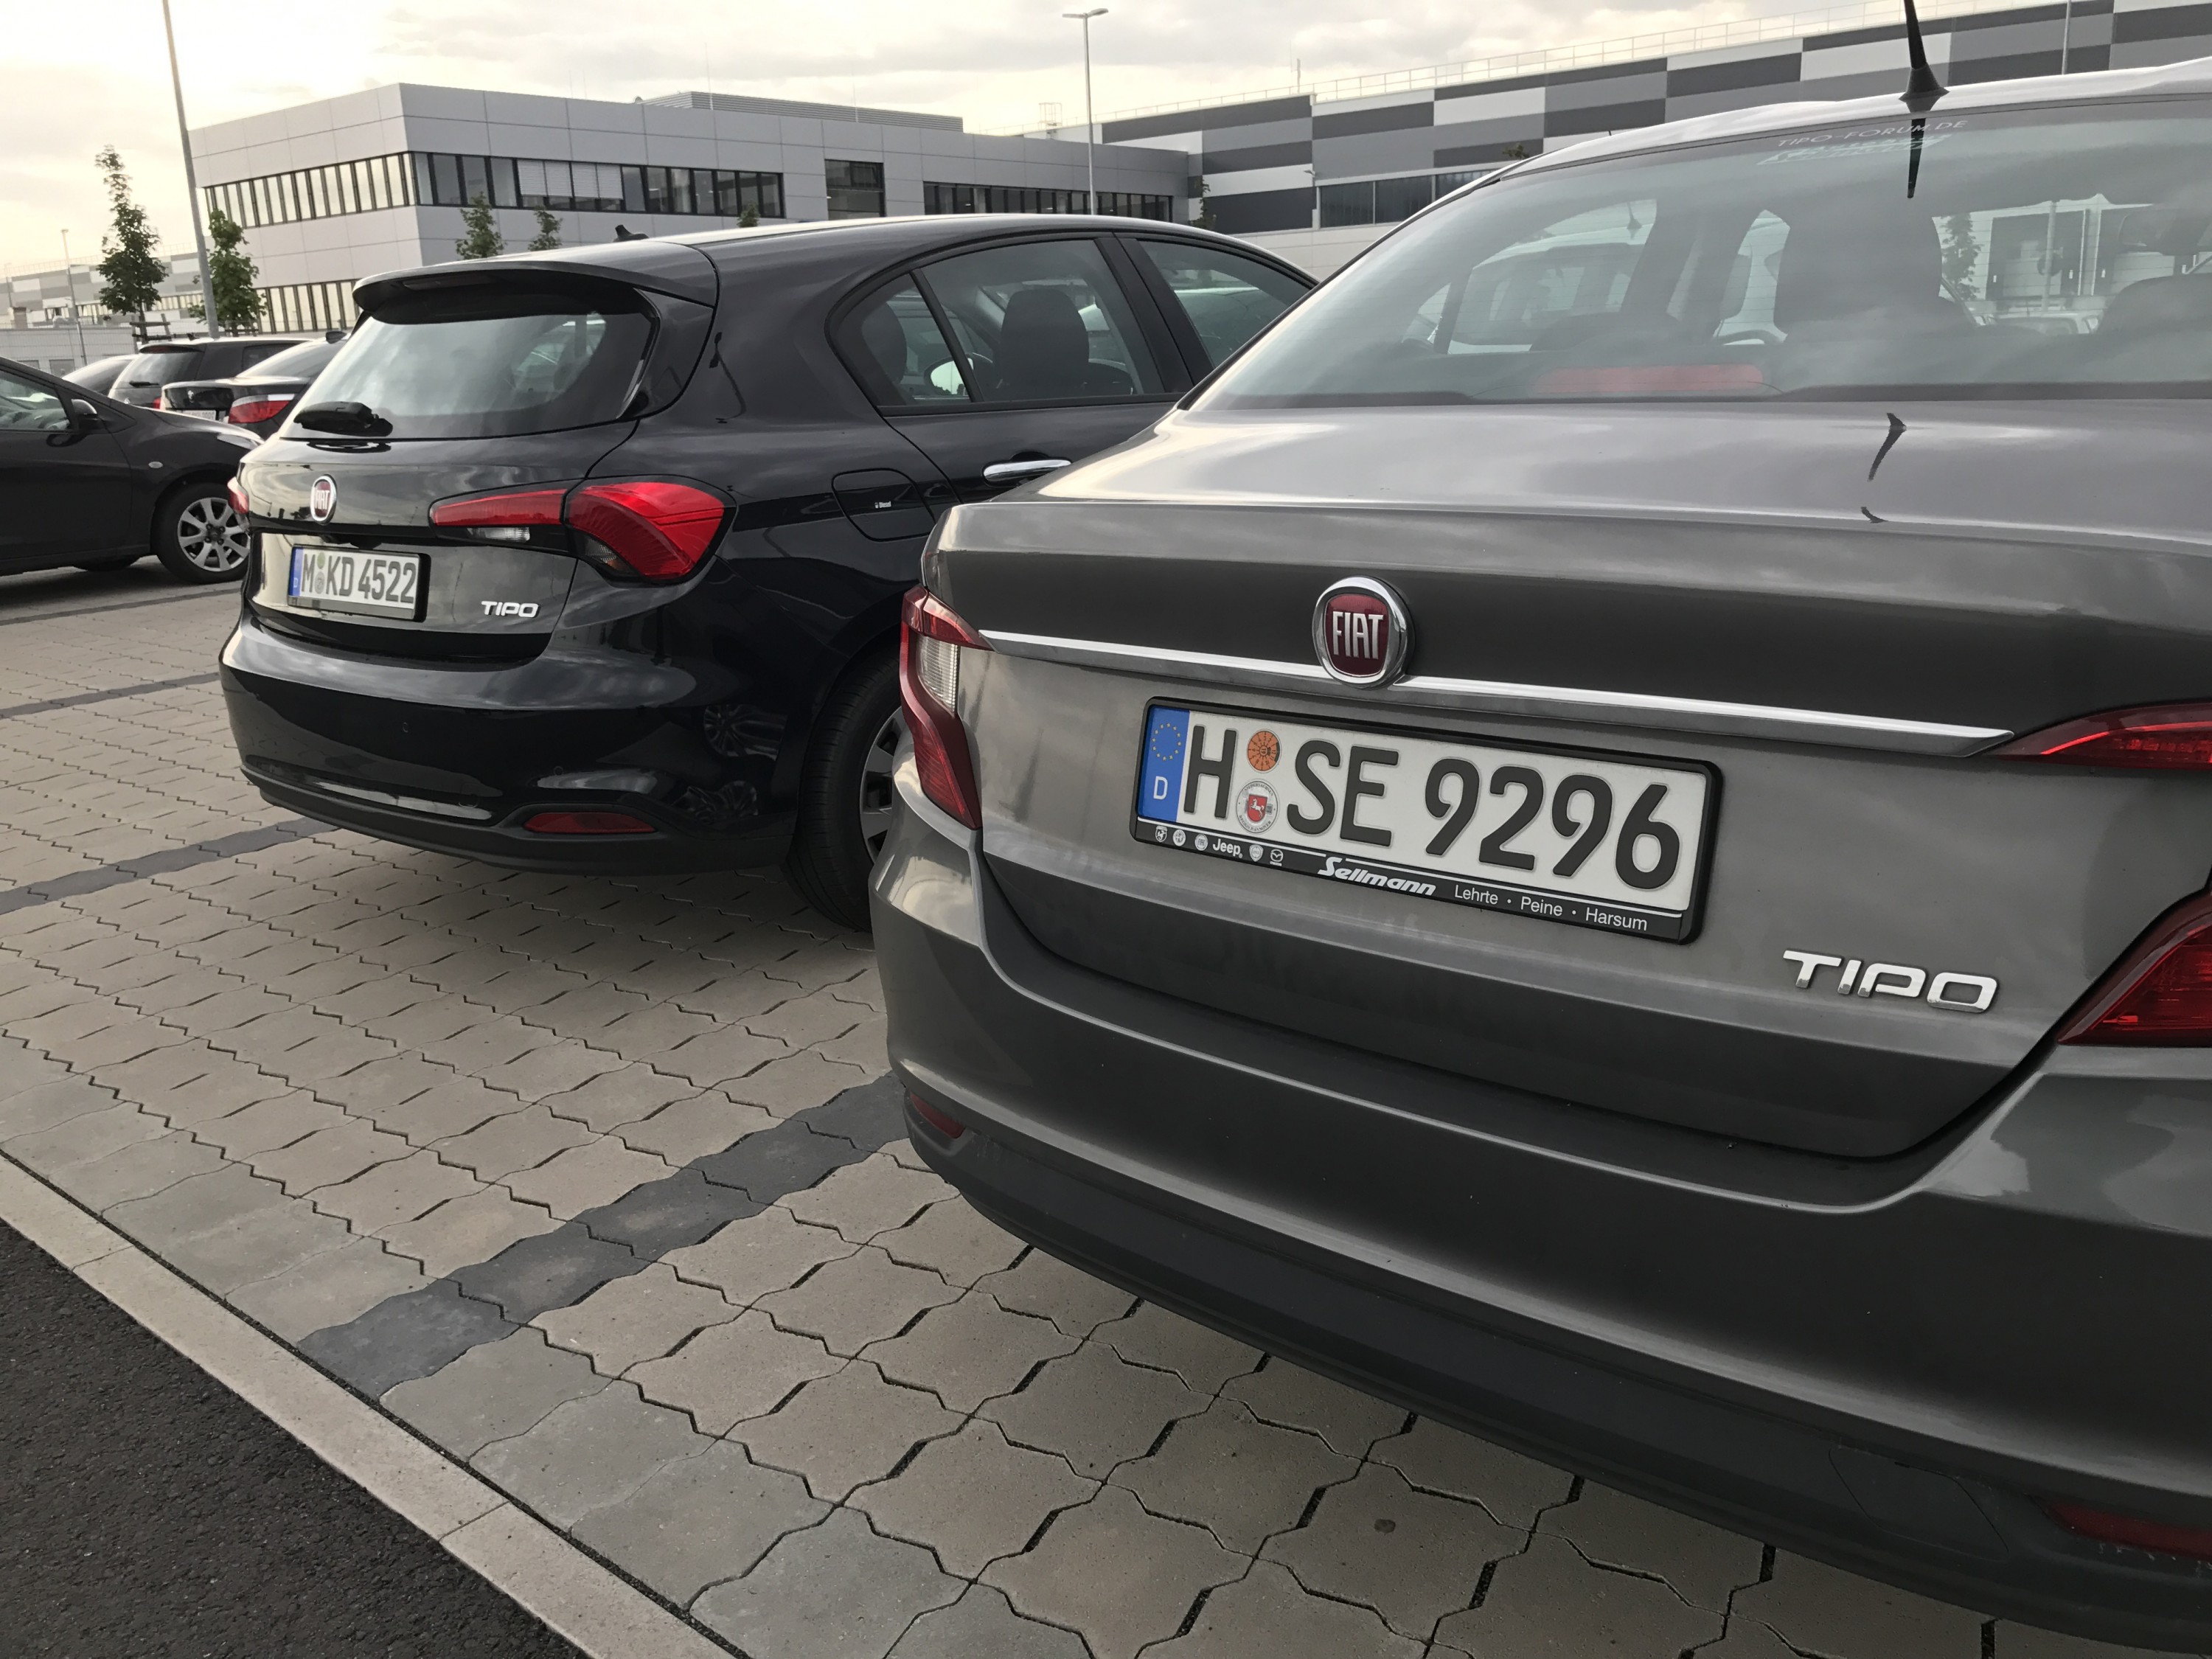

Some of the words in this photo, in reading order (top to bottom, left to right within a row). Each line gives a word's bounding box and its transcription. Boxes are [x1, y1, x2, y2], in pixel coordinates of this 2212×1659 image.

[1778, 120, 1968, 147] TIPO-FORUM.DE
[315, 490, 330, 510] FIAT
[301, 553, 316, 593] M
[325, 555, 354, 597] KD
[358, 559, 417, 603] 4522
[481, 600, 540, 618] TIPO
[1332, 611, 1384, 660] FIAT
[1153, 776, 1168, 801] D
[1183, 725, 1238, 819] H
[1286, 740, 1399, 847] SE
[1424, 758, 1681, 890] 9296
[1212, 838, 1241, 857] Jeep
[1318, 856, 1436, 896] Sellmann
[1455, 885, 1498, 905] Lehrte
[1520, 897, 1563, 917] Peine
[1585, 908, 1648, 931] Harsum
[1783, 950, 1997, 1013] TIPO
